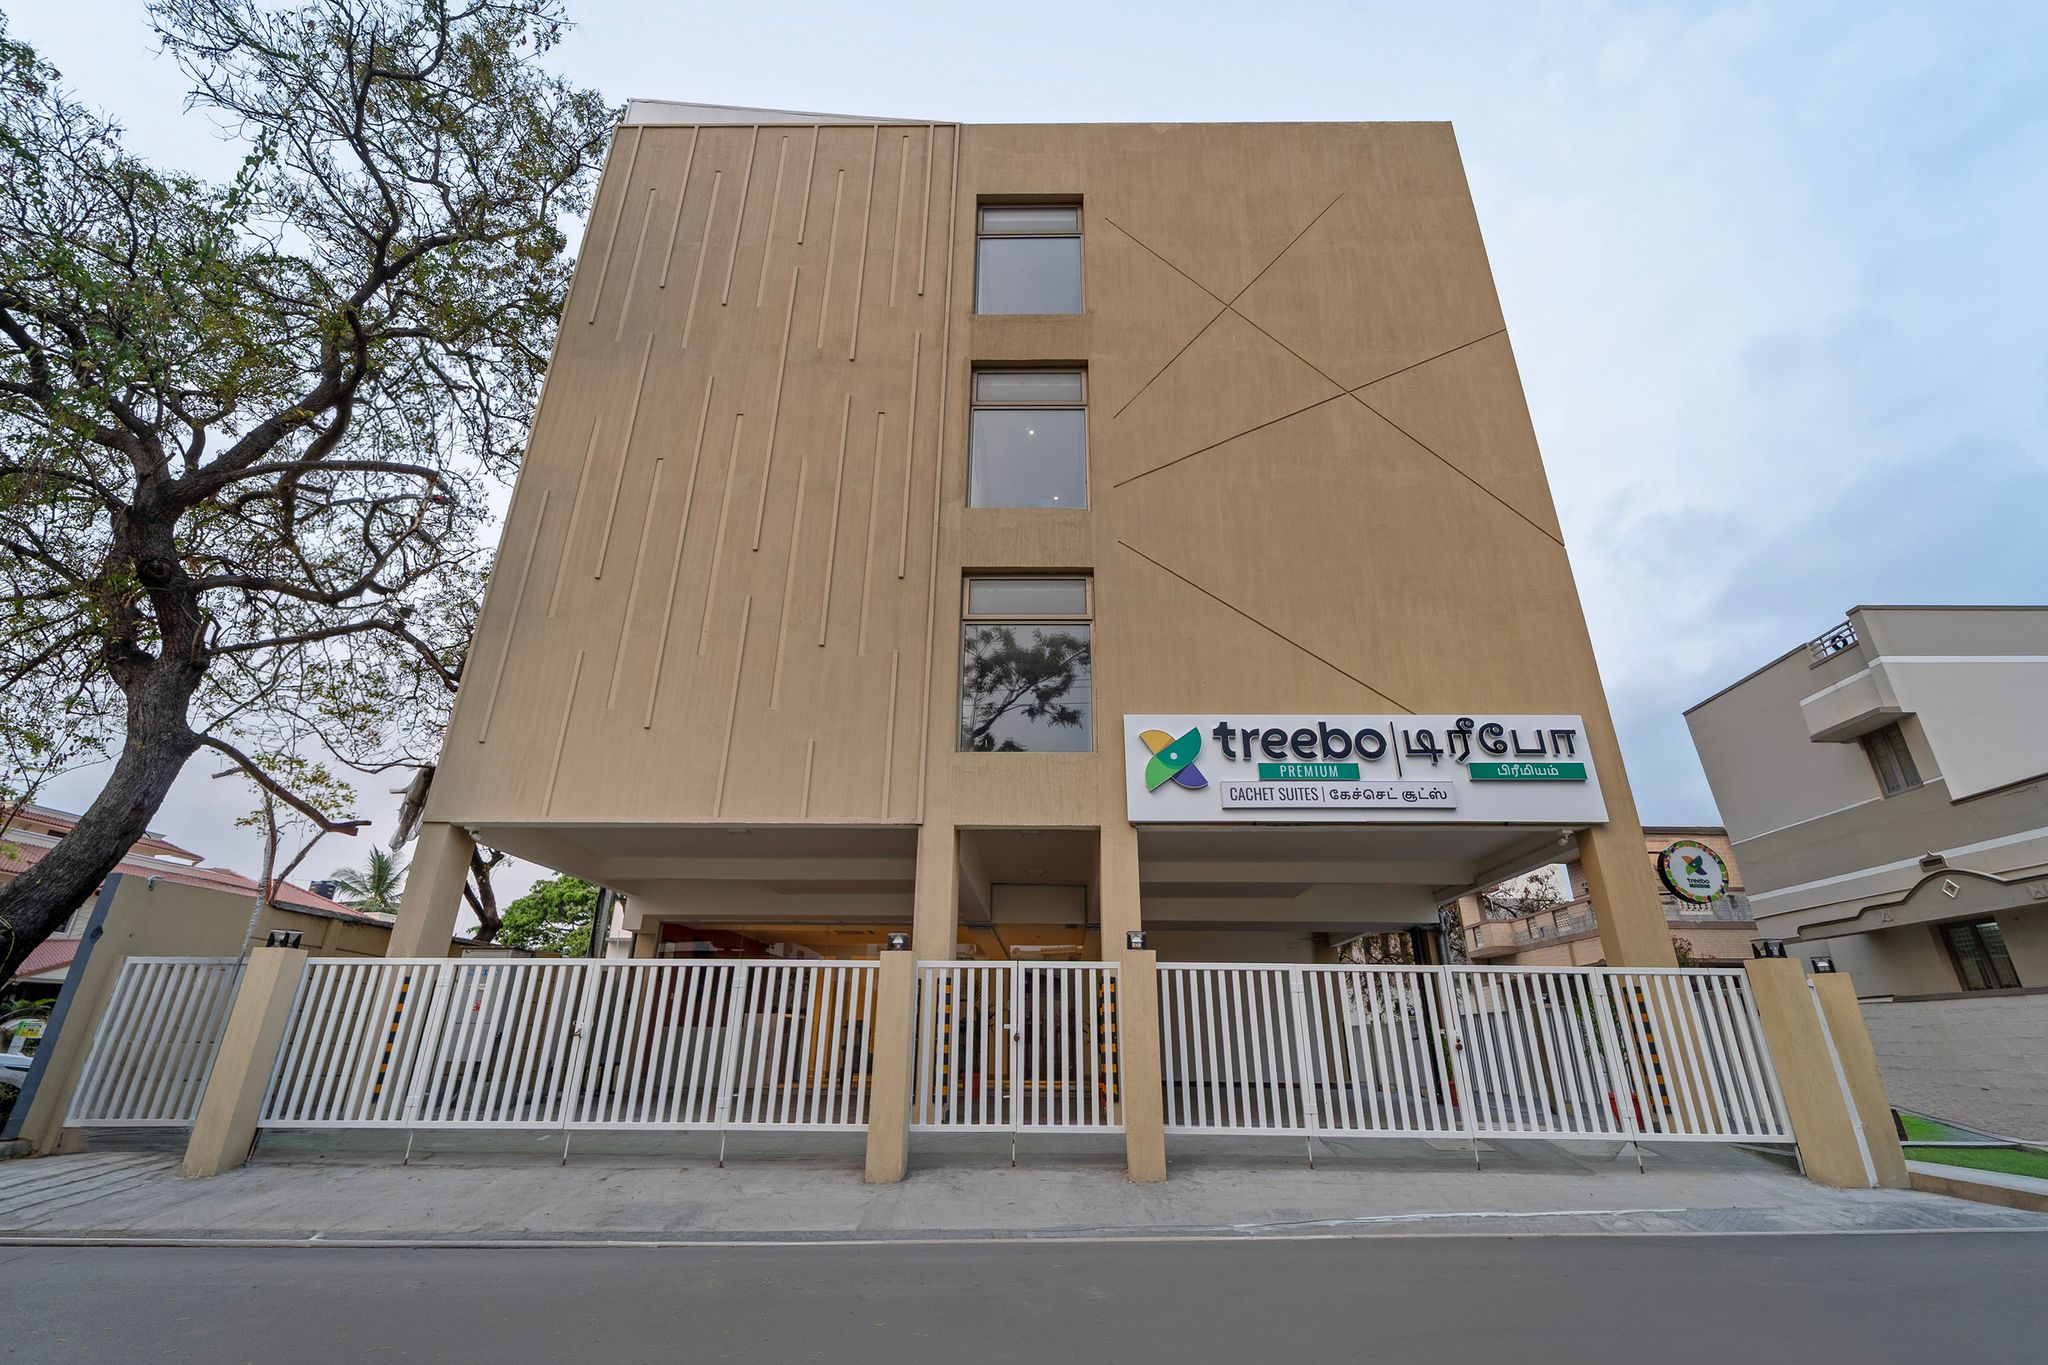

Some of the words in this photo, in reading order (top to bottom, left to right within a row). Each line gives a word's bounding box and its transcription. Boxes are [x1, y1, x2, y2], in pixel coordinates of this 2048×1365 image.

[1213, 721, 1387, 761] treebo
[1402, 717, 1576, 764] டிரீபோ
[1279, 765, 1339, 778] PREMIUM
[1497, 764, 1559, 777] பிரீமியம்
[1229, 786, 1275, 801] CACHET
[1278, 786, 1319, 801] SUITES
[1329, 787, 1398, 800] கேச்செட்
[1402, 787, 1447, 802] சூட்ஸ்
